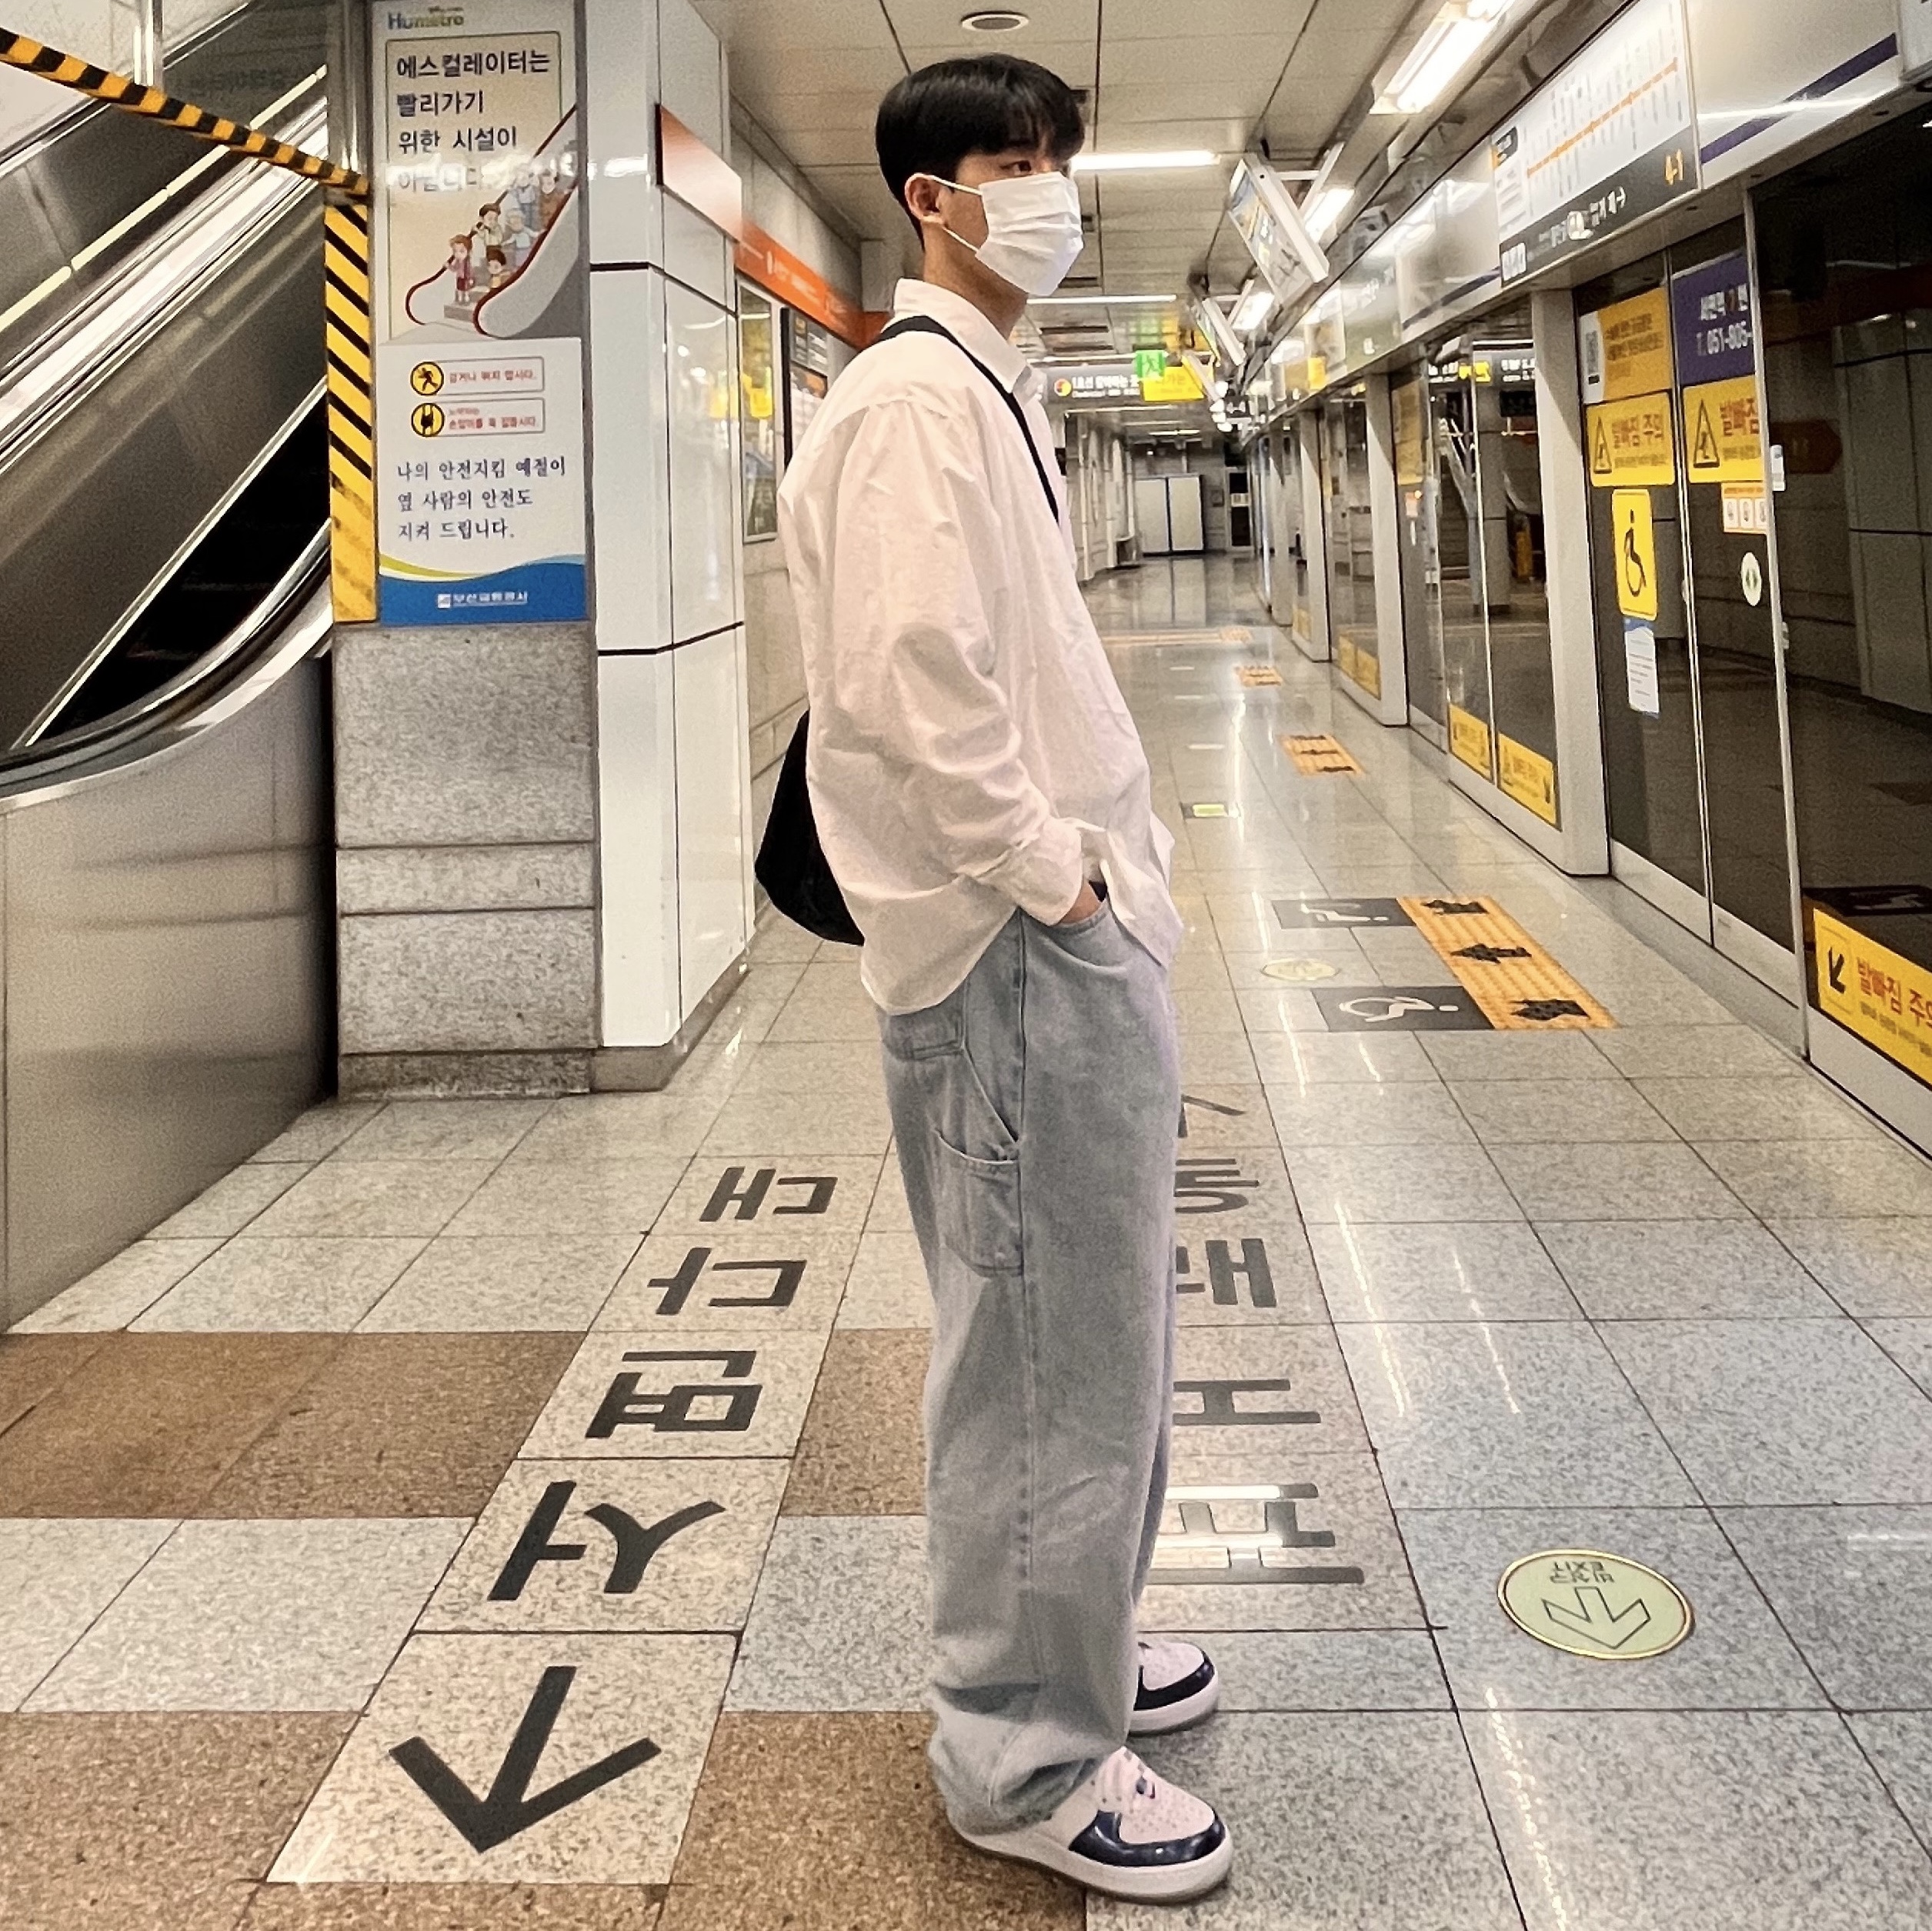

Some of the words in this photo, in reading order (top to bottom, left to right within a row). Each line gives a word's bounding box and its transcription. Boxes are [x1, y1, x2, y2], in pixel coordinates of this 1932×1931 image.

[396, 49, 551, 78] 에스컬레이터는
[396, 89, 485, 118] 빨리가기
[399, 129, 441, 155] 위한
[452, 125, 518, 152] 시설이
[397, 461, 429, 482] 나의
[439, 458, 506, 482] 안전지킴
[516, 455, 566, 478] 예절이
[398, 492, 413, 512] 옆
[422, 489, 473, 512] 사람의
[481, 487, 534, 509] 안전도
[399, 521, 431, 542] 지켜
[439, 518, 516, 541] 드립니다.
